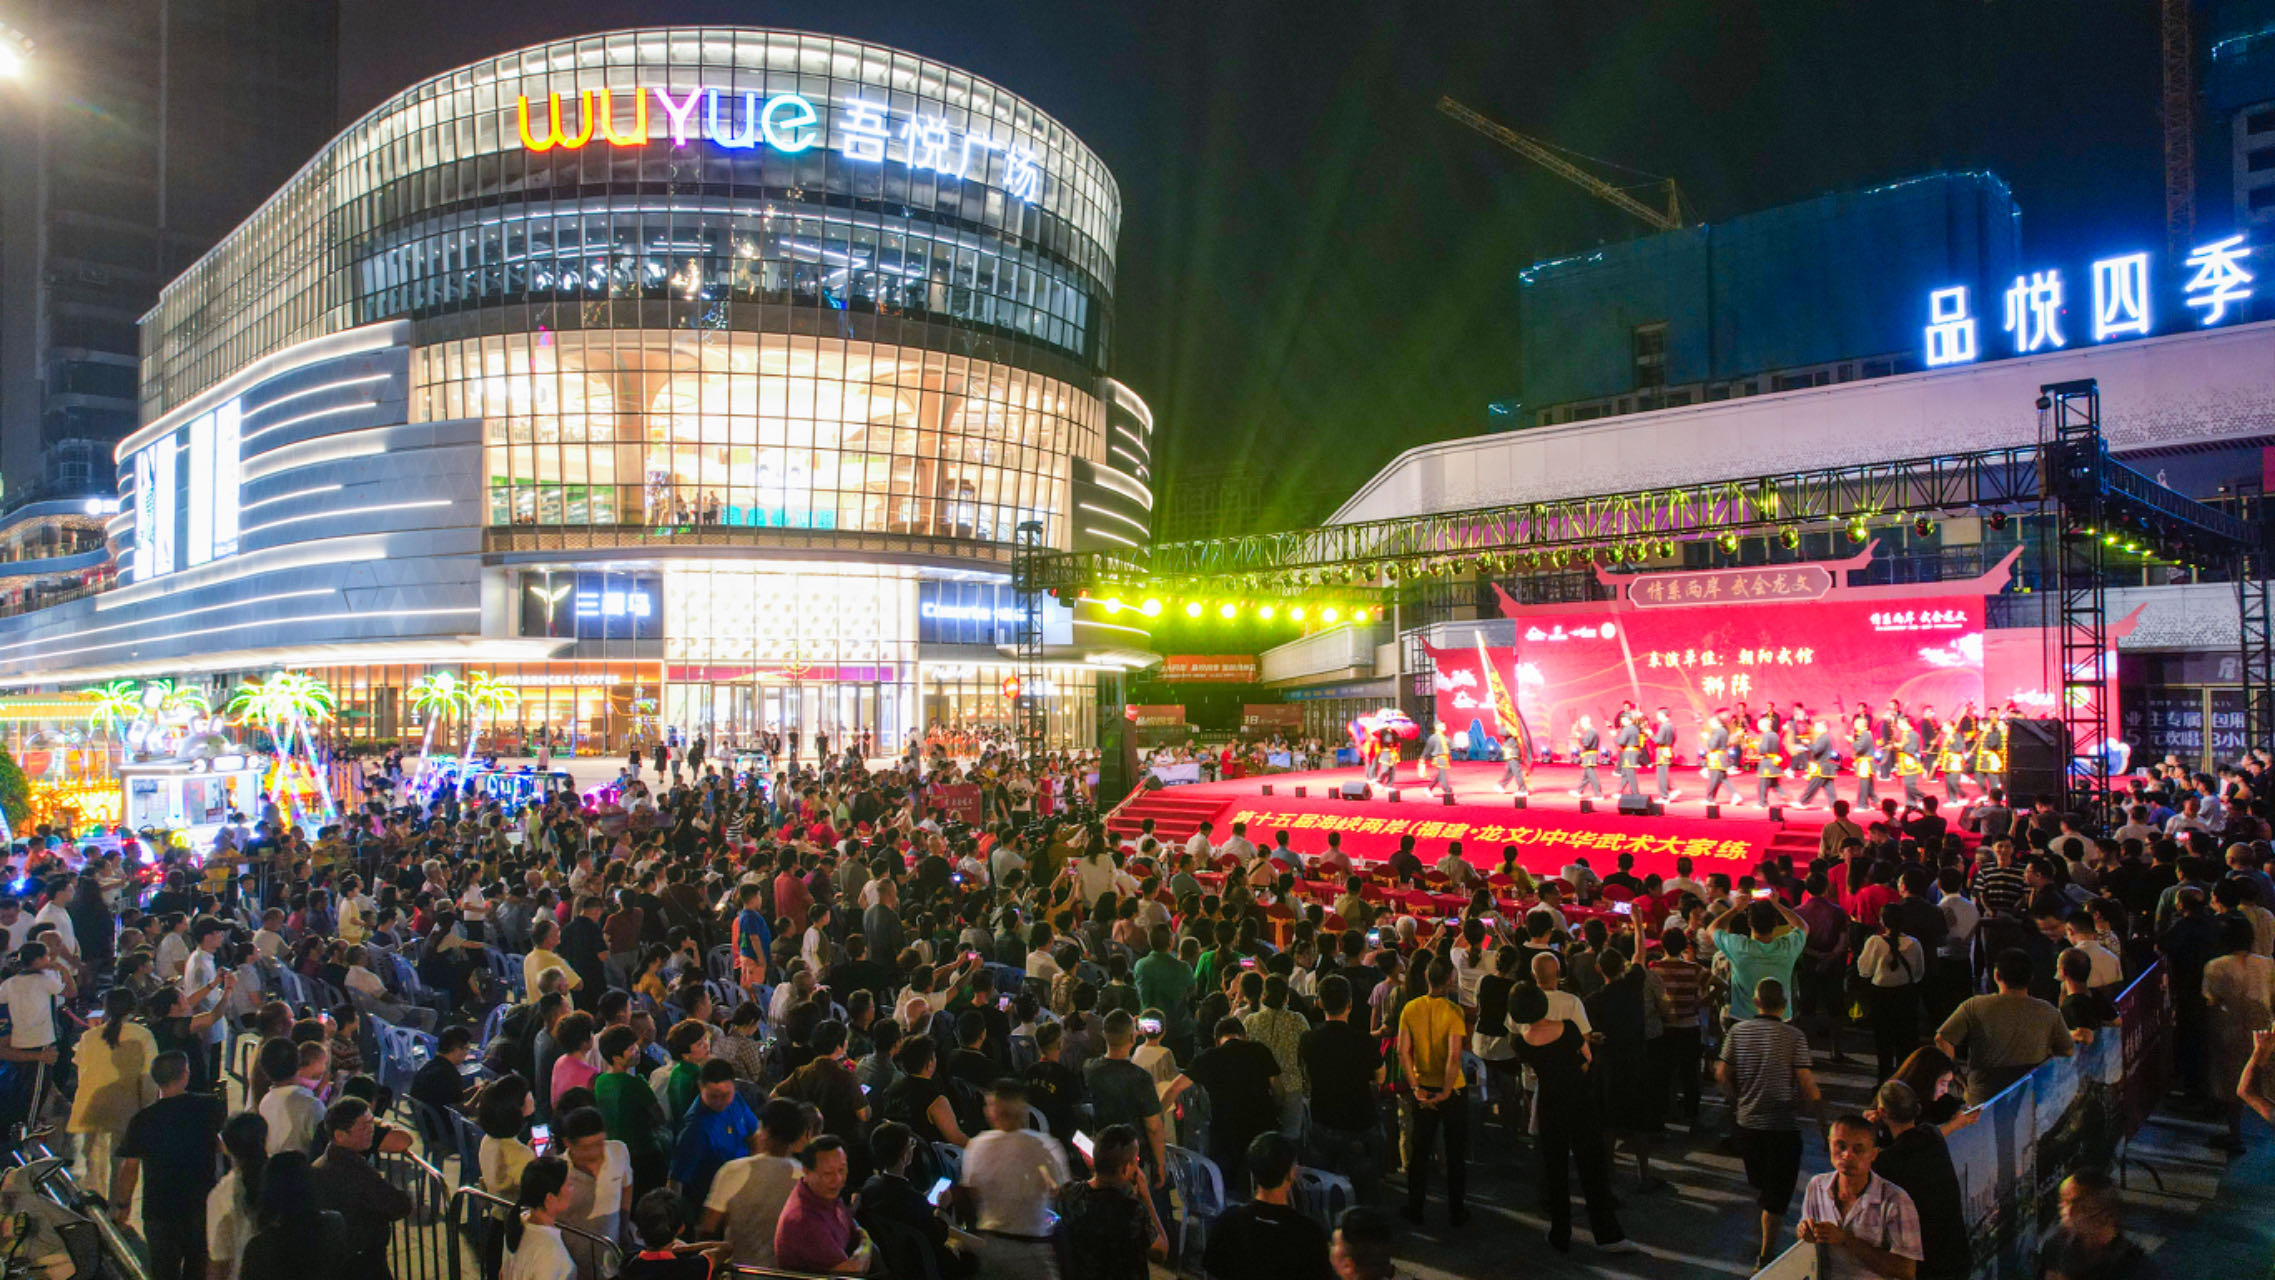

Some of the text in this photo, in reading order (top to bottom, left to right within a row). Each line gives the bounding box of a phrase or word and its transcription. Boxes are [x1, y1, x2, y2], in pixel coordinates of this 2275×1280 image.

[839, 98, 1041, 202] 吾悦广场
[1925, 235, 2252, 366] 品悦四季
[573, 675, 620, 685] COFFEE
